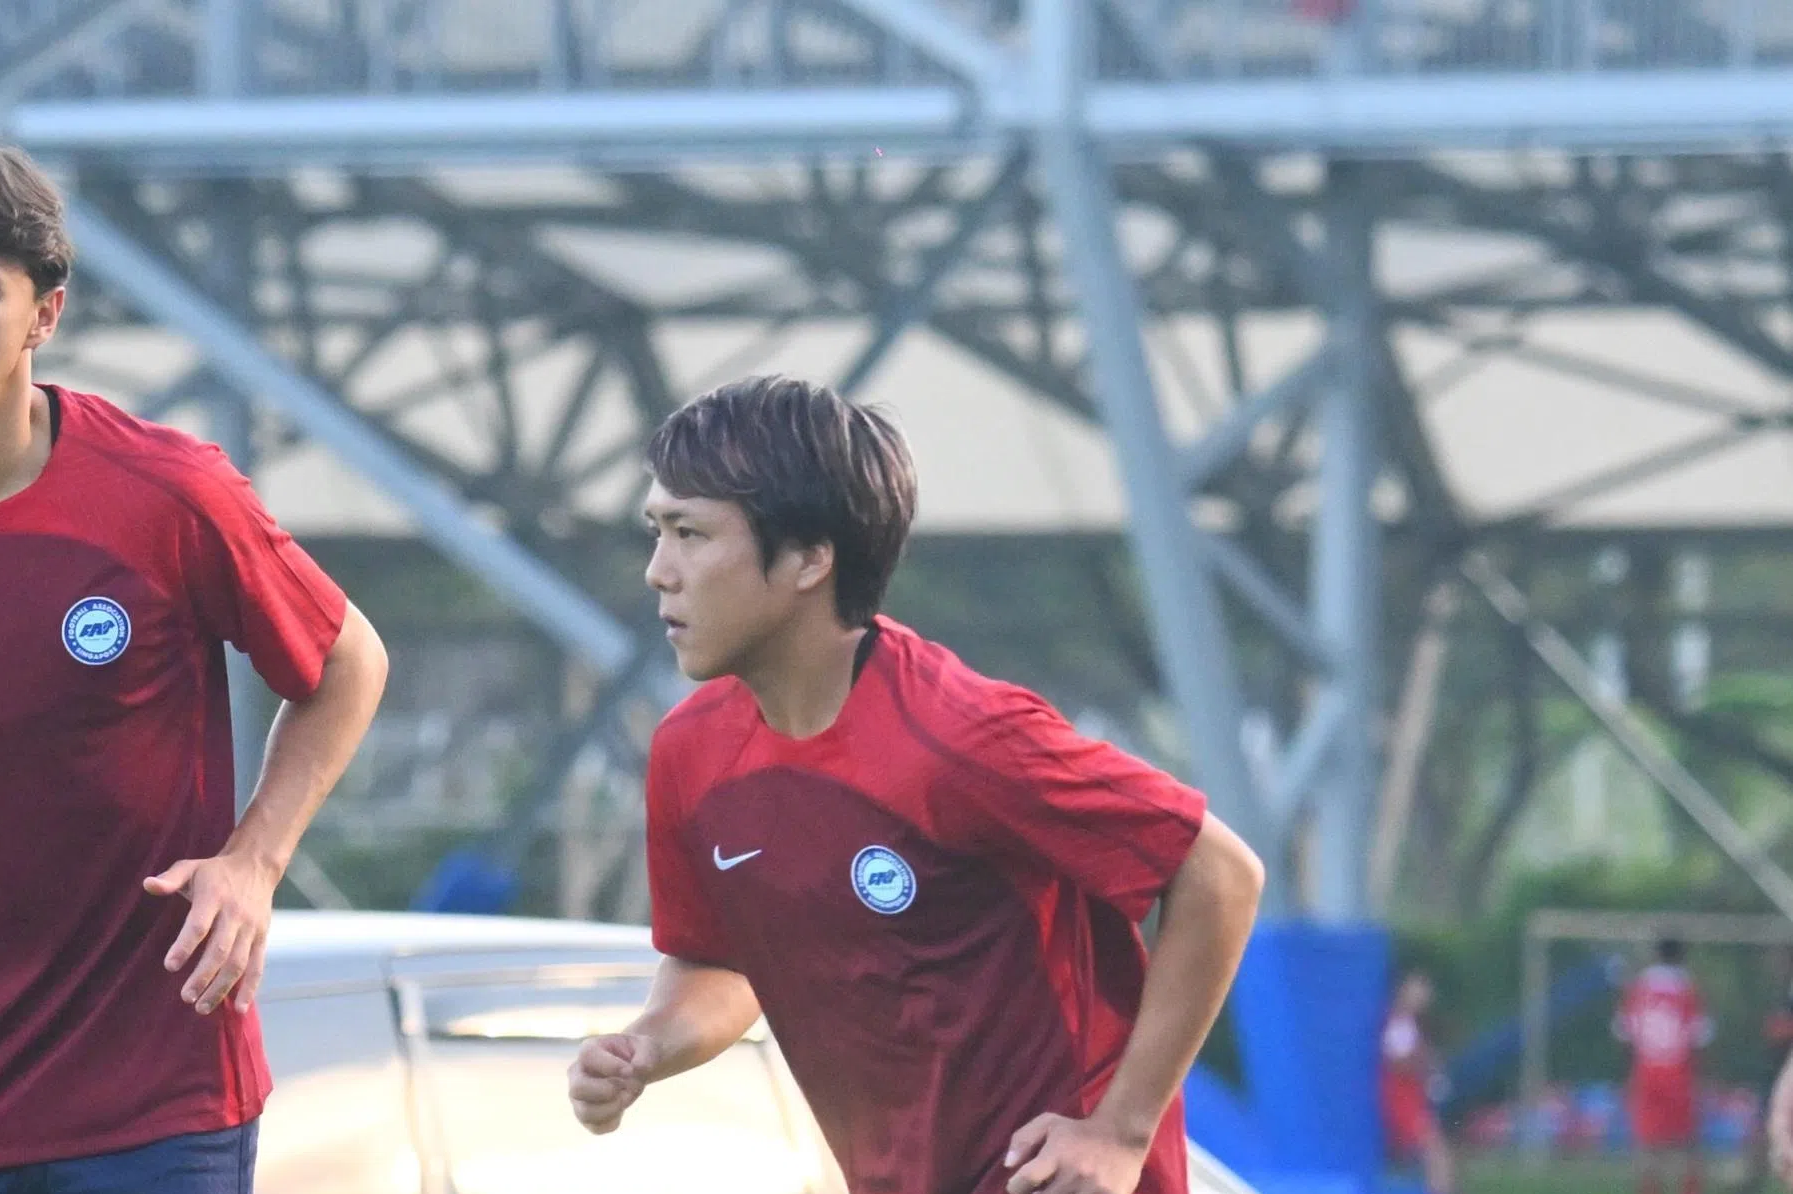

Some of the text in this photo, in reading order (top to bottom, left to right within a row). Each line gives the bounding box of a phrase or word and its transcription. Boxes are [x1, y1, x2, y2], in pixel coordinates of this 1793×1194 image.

[68, 603, 126, 639] FOOTBALL ASSOCIATION
[75, 646, 118, 660] SINGAPORE
